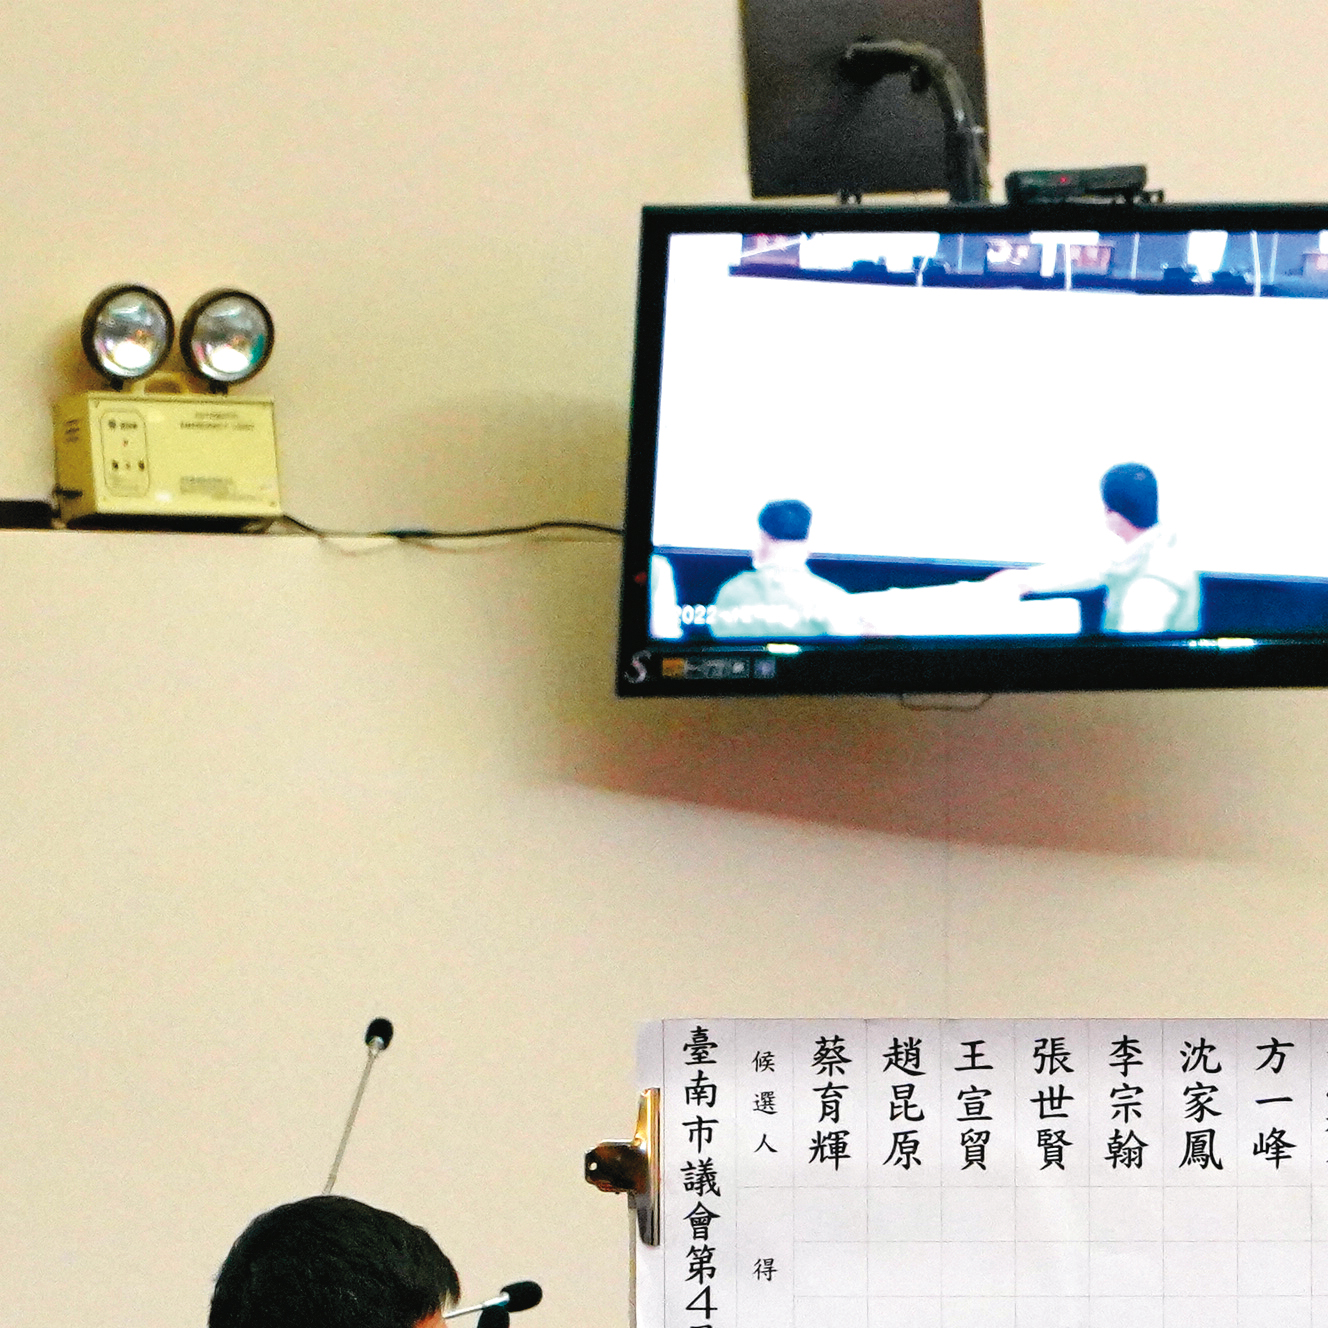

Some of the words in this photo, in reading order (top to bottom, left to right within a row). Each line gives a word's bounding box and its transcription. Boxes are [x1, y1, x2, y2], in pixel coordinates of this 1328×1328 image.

[753, 1051, 776, 1152] 候選人
[810, 1035, 851, 1169] 蔡育輝
[884, 1037, 924, 1169] 趙昆原
[955, 1040, 993, 1170] 王宣貿
[1031, 1037, 1073, 1170] 張世賢
[1106, 1035, 1147, 1168] 李宗翰
[1180, 1038, 1223, 1169] 沈家鳳
[1253, 1038, 1295, 1168] 方一峰
